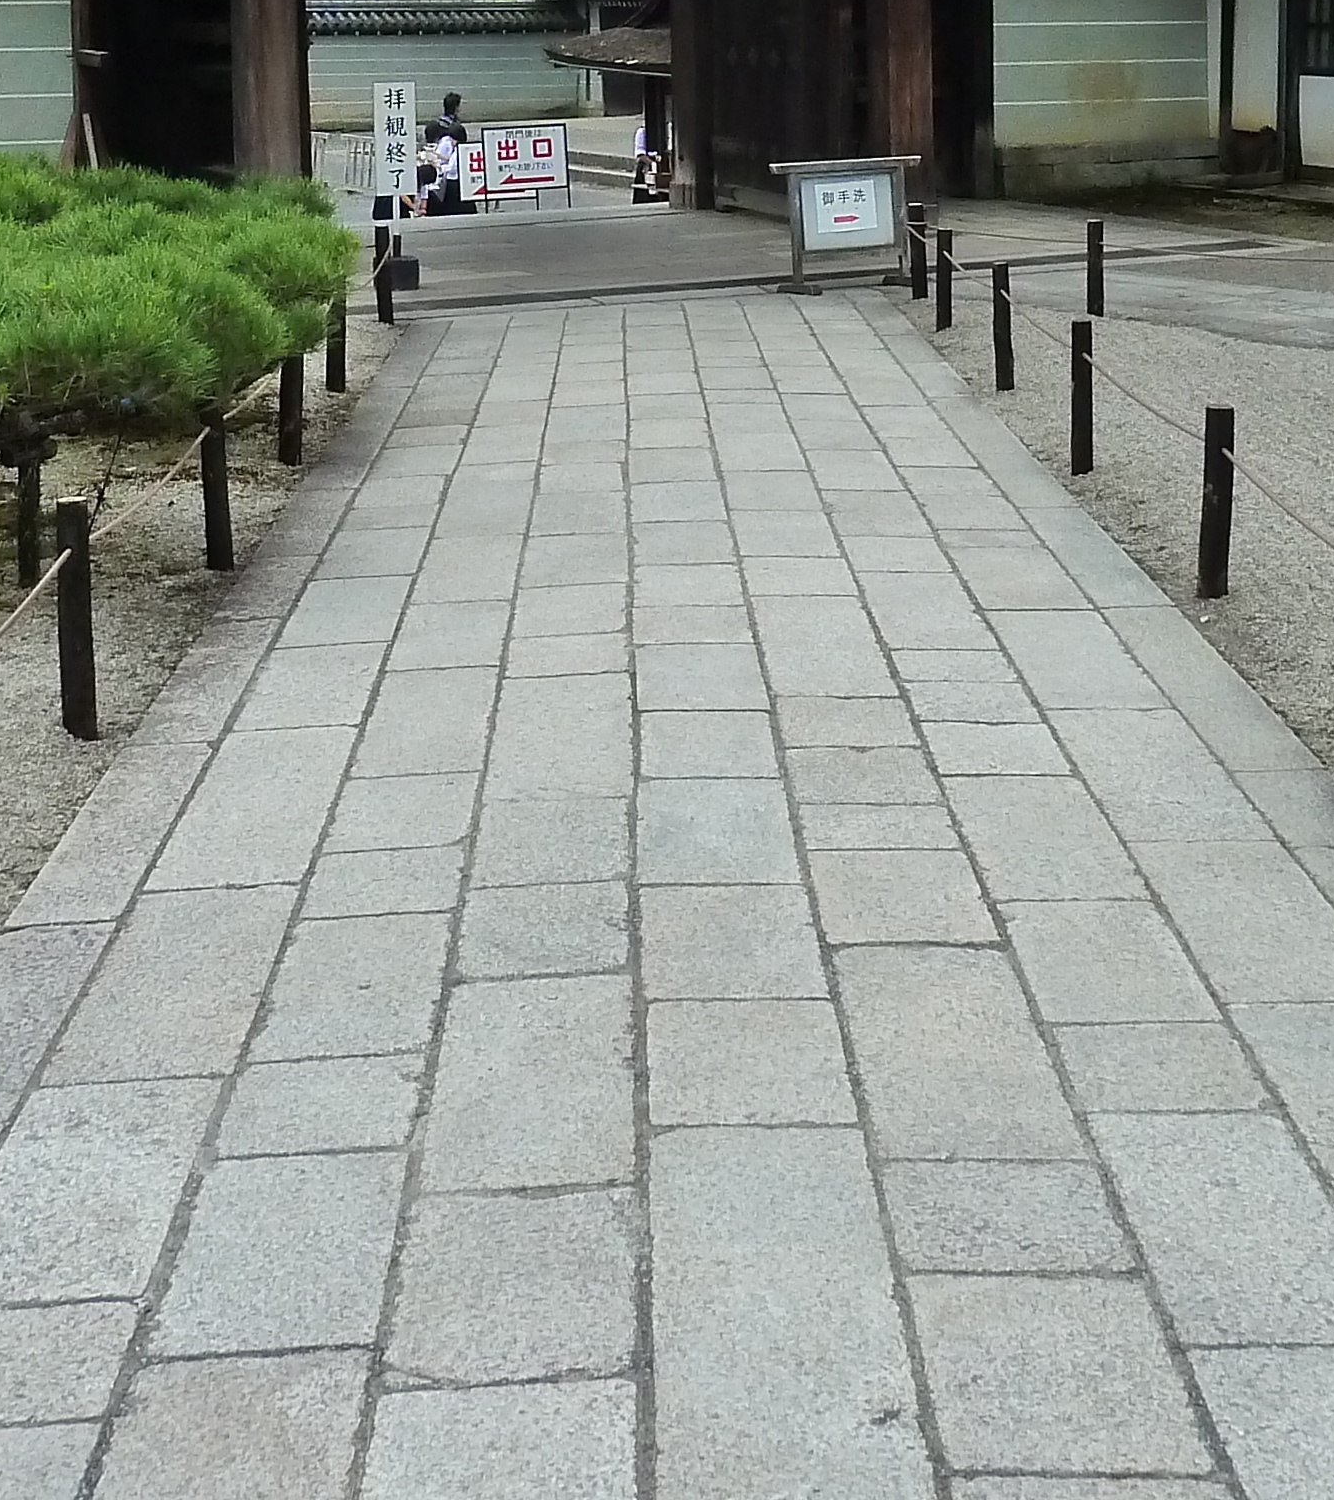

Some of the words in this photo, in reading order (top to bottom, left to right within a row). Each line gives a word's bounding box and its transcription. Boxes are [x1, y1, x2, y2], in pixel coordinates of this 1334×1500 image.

[384, 88, 408, 189] 拝観終了
[497, 138, 553, 161] 出口
[822, 188, 866, 206] 御手洗
